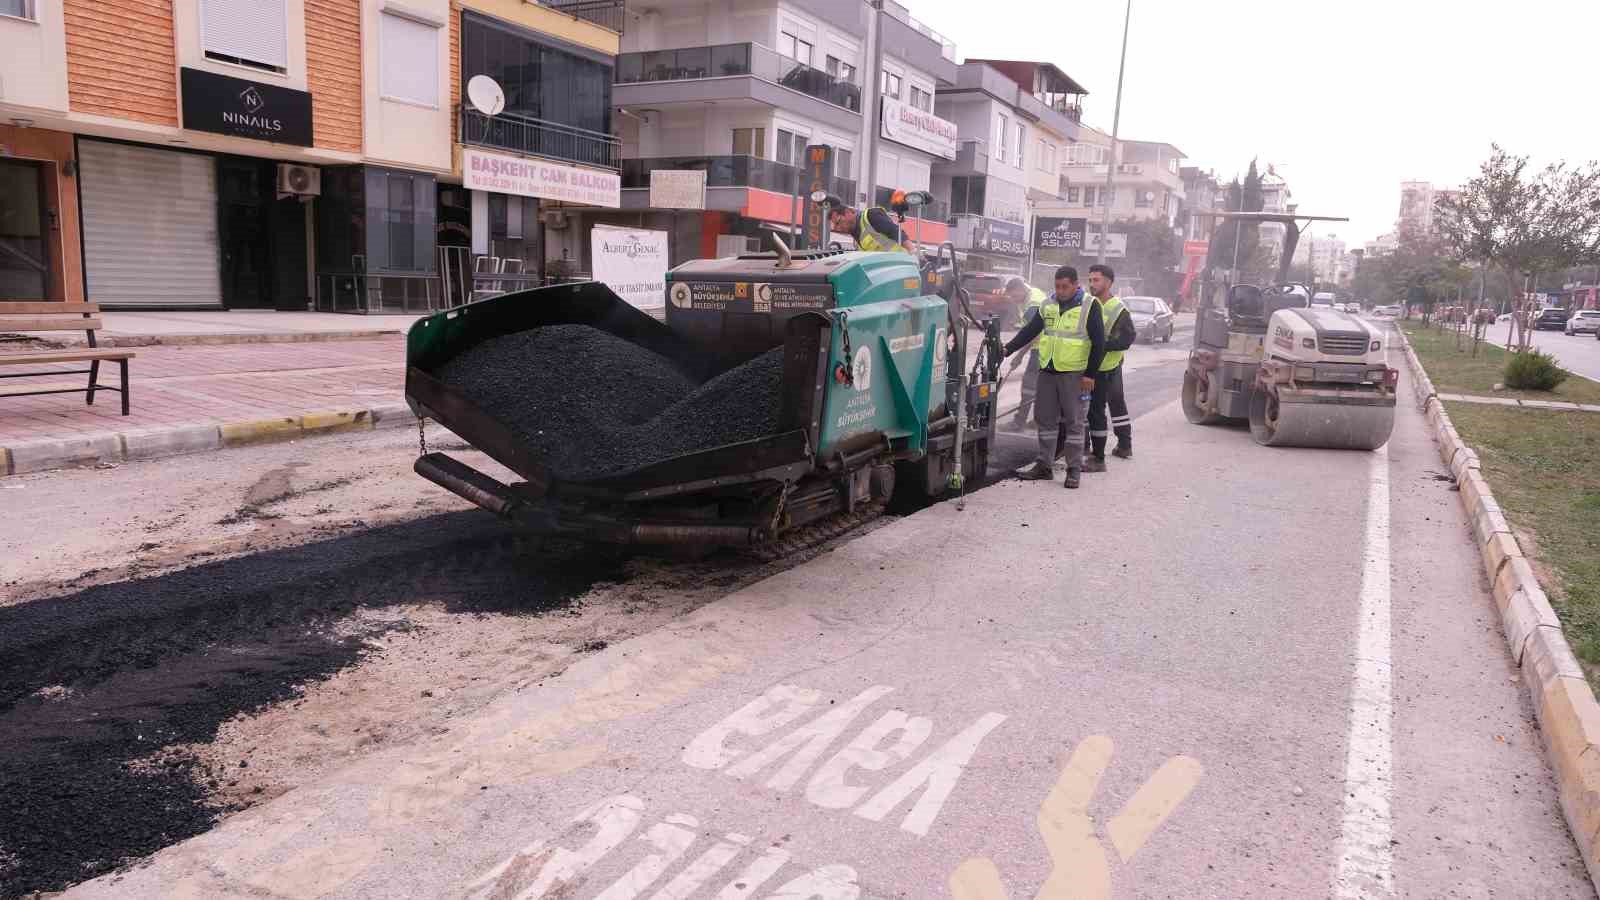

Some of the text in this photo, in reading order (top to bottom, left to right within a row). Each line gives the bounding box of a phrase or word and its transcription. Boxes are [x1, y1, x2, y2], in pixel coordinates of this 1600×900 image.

[223, 112, 281, 131] NINAILS
[471, 155, 536, 178] BAŞKENT
[539, 167, 568, 184] CAM
[570, 174, 617, 192] BALKON
